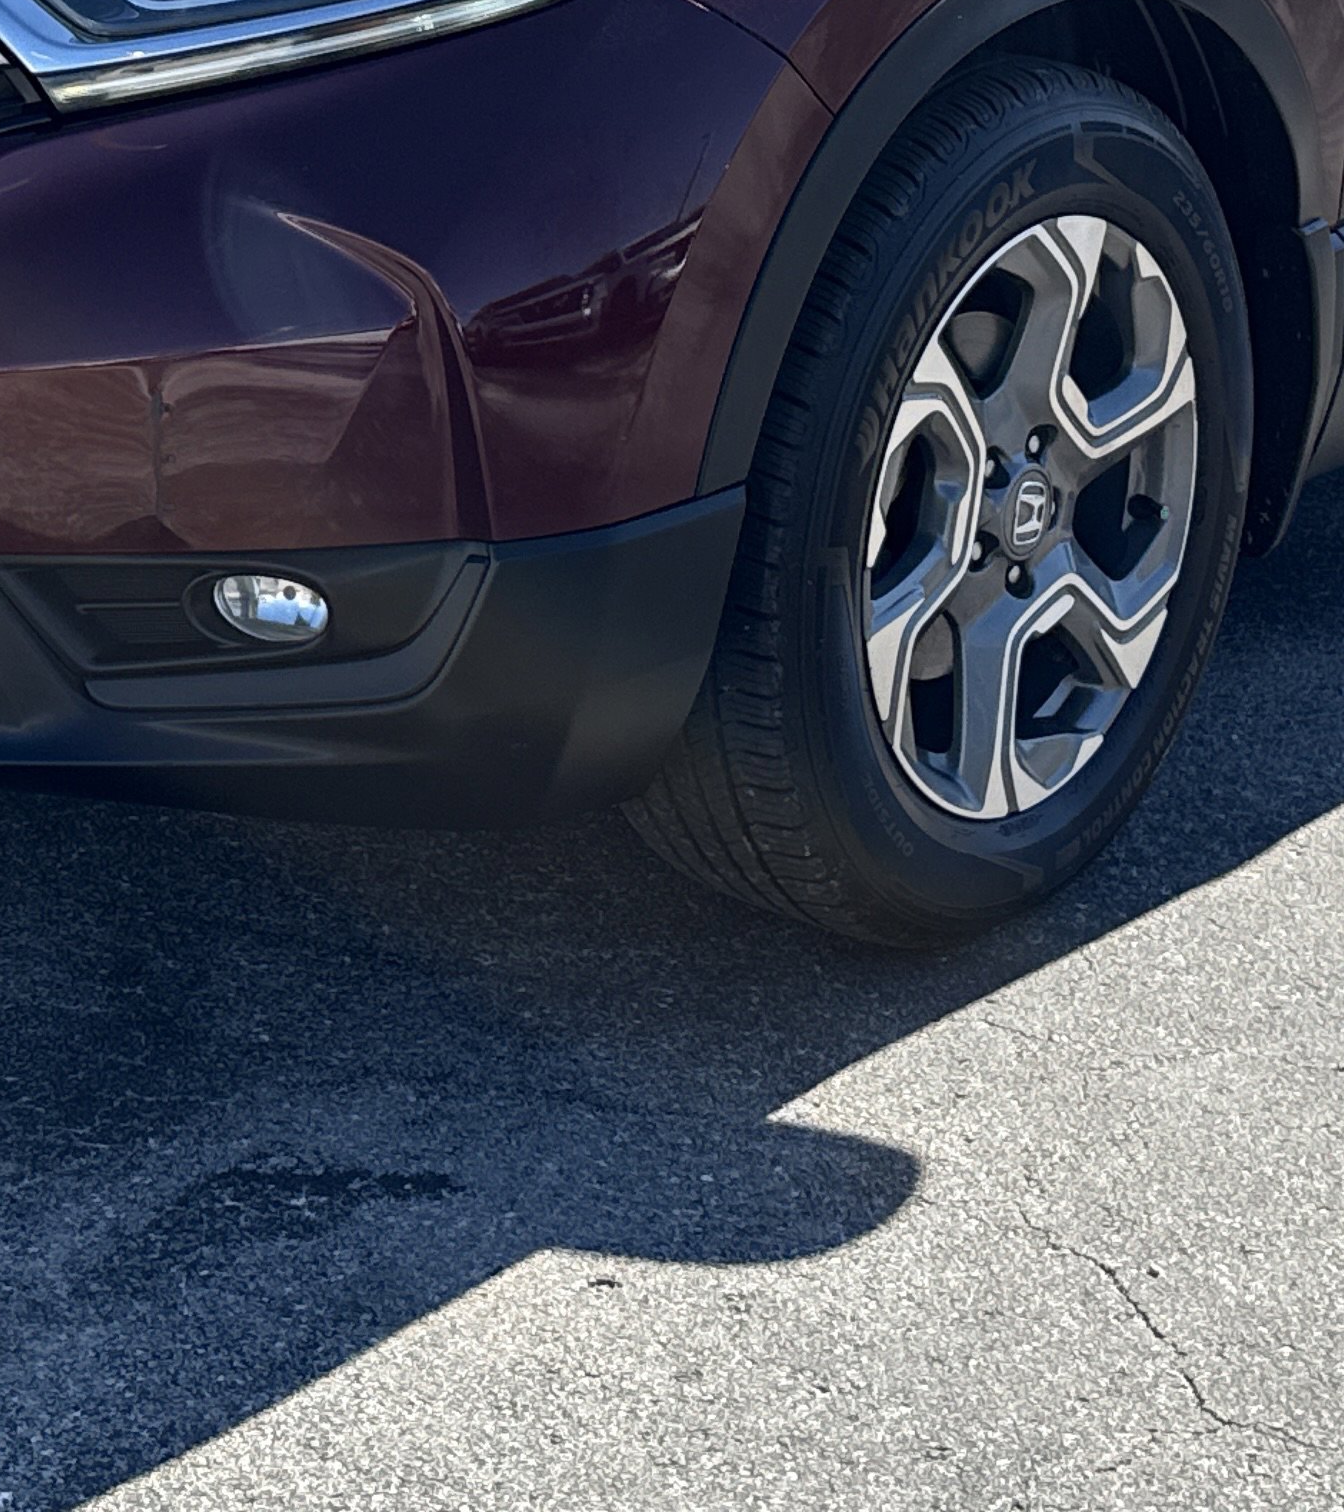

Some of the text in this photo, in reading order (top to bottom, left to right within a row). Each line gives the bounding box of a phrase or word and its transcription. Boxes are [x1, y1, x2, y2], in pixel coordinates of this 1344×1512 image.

[1081, 513, 1237, 845] MAVIS TRACTION CONTROL
[861, 770, 915, 858] OUTSIDE
